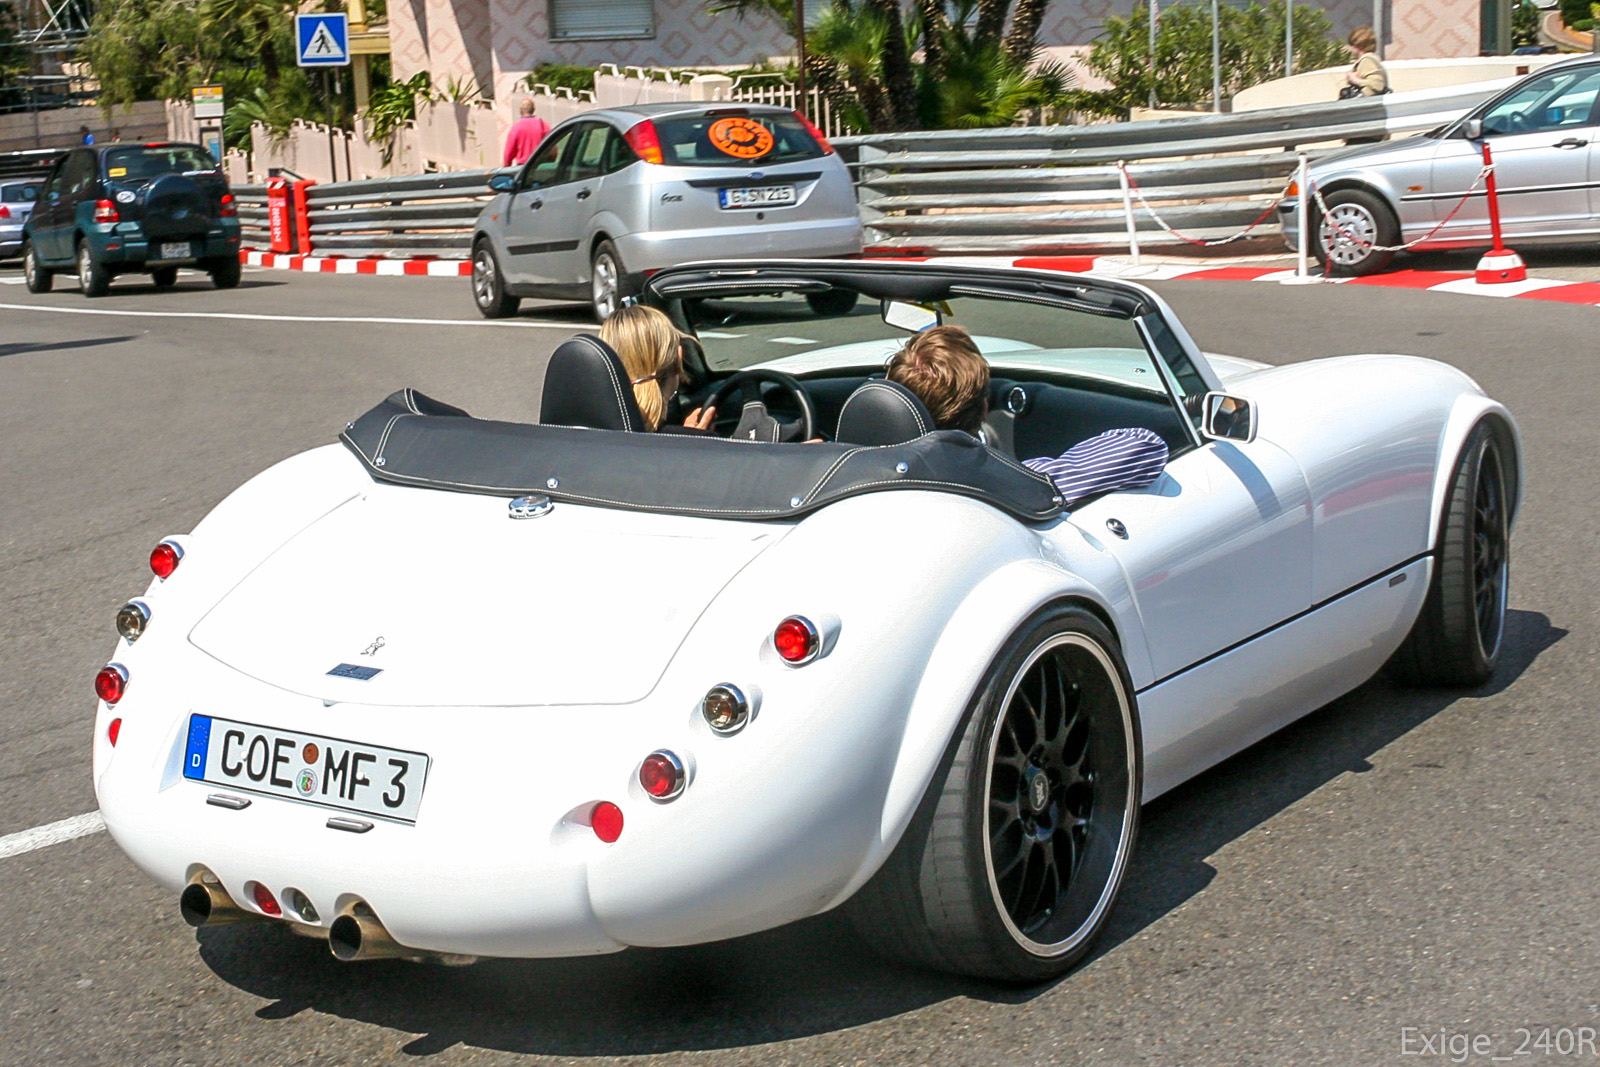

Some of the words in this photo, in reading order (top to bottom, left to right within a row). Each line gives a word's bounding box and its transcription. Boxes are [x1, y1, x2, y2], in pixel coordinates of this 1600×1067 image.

[191, 754, 201, 767] D
[221, 729, 296, 789] COE
[321, 746, 377, 801] MF
[382, 758, 409, 808] 3
